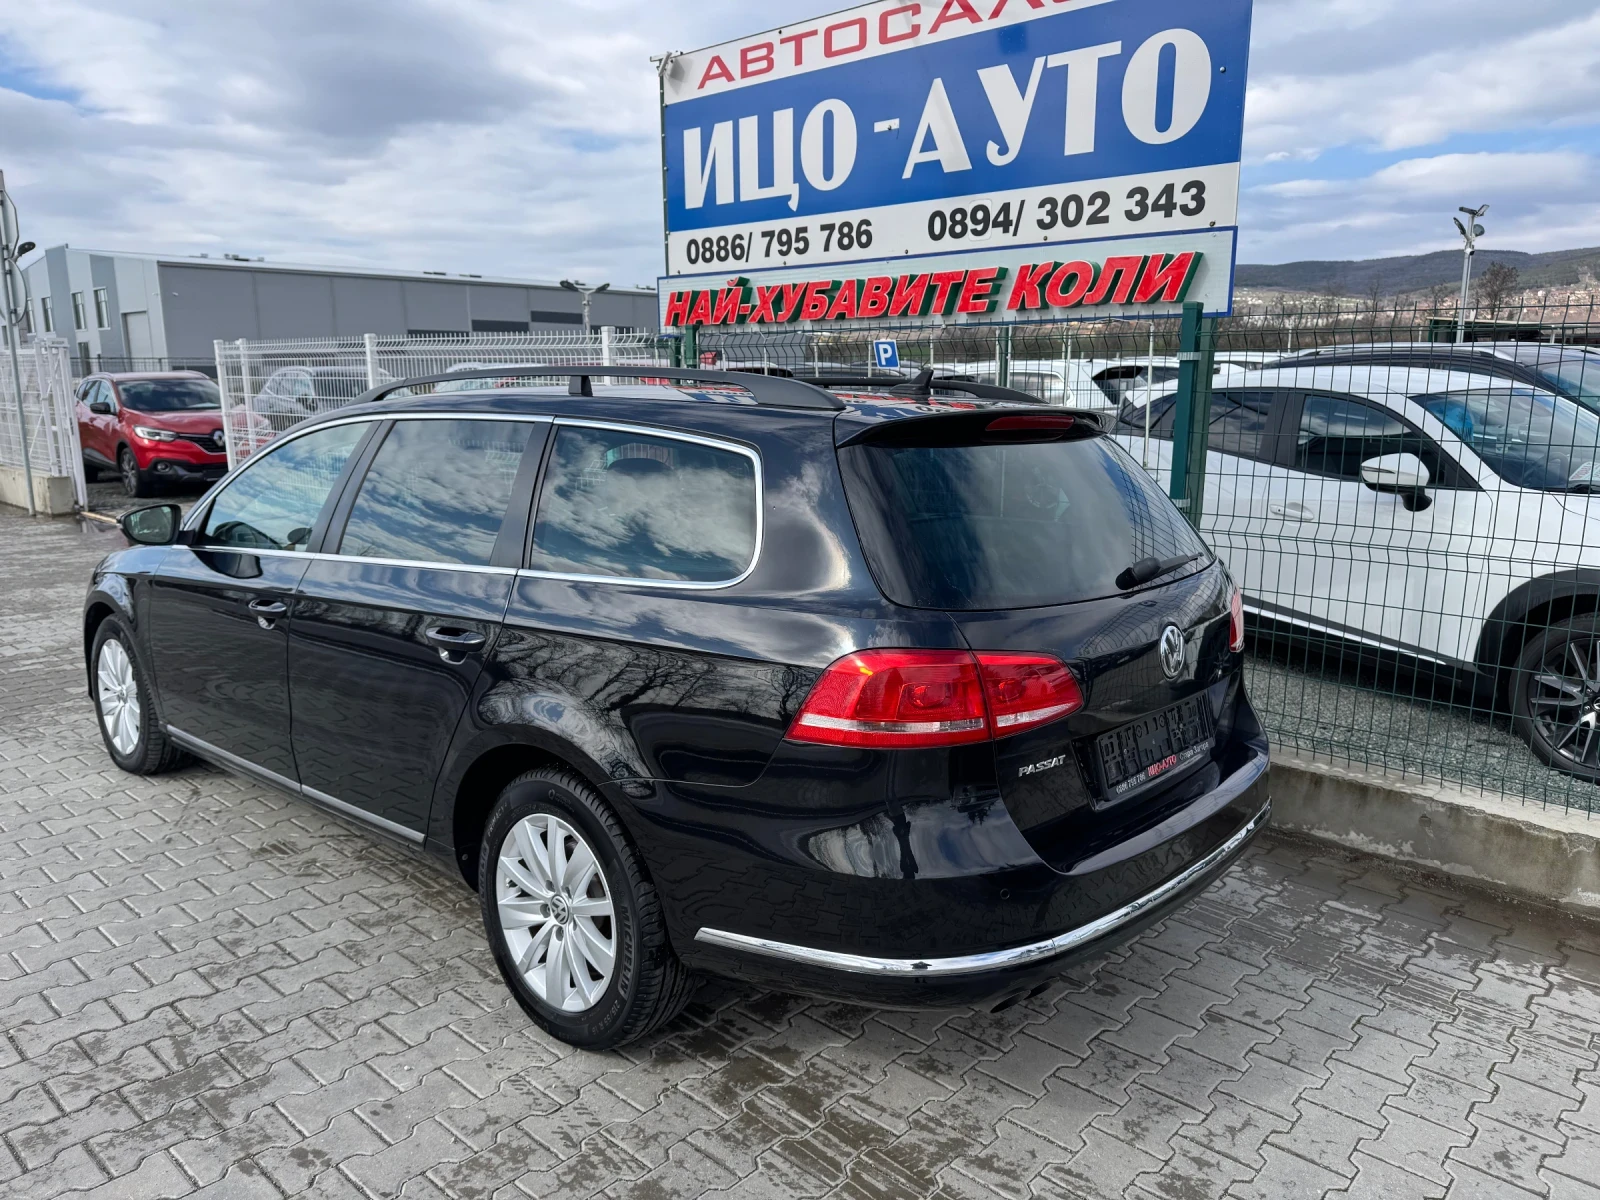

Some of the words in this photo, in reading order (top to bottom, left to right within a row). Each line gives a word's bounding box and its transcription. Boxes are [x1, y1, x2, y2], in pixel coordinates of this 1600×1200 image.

[697, 0, 1079, 89] АВТОСА
[686, 233, 752, 265] 0886/
[761, 227, 809, 257] 795
[820, 219, 873, 252] 786
[927, 200, 1025, 241] 0894/
[1036, 192, 1110, 231] 302
[1124, 180, 1207, 222] 343
[664, 267, 1007, 327] НАЙ-ХУБАВИТЕ
[1007, 251, 1203, 311] КОЛИ
[878, 344, 892, 366] P
[1018, 754, 1066, 777] PASSAT
[619, 905, 634, 997] MICHELIN
